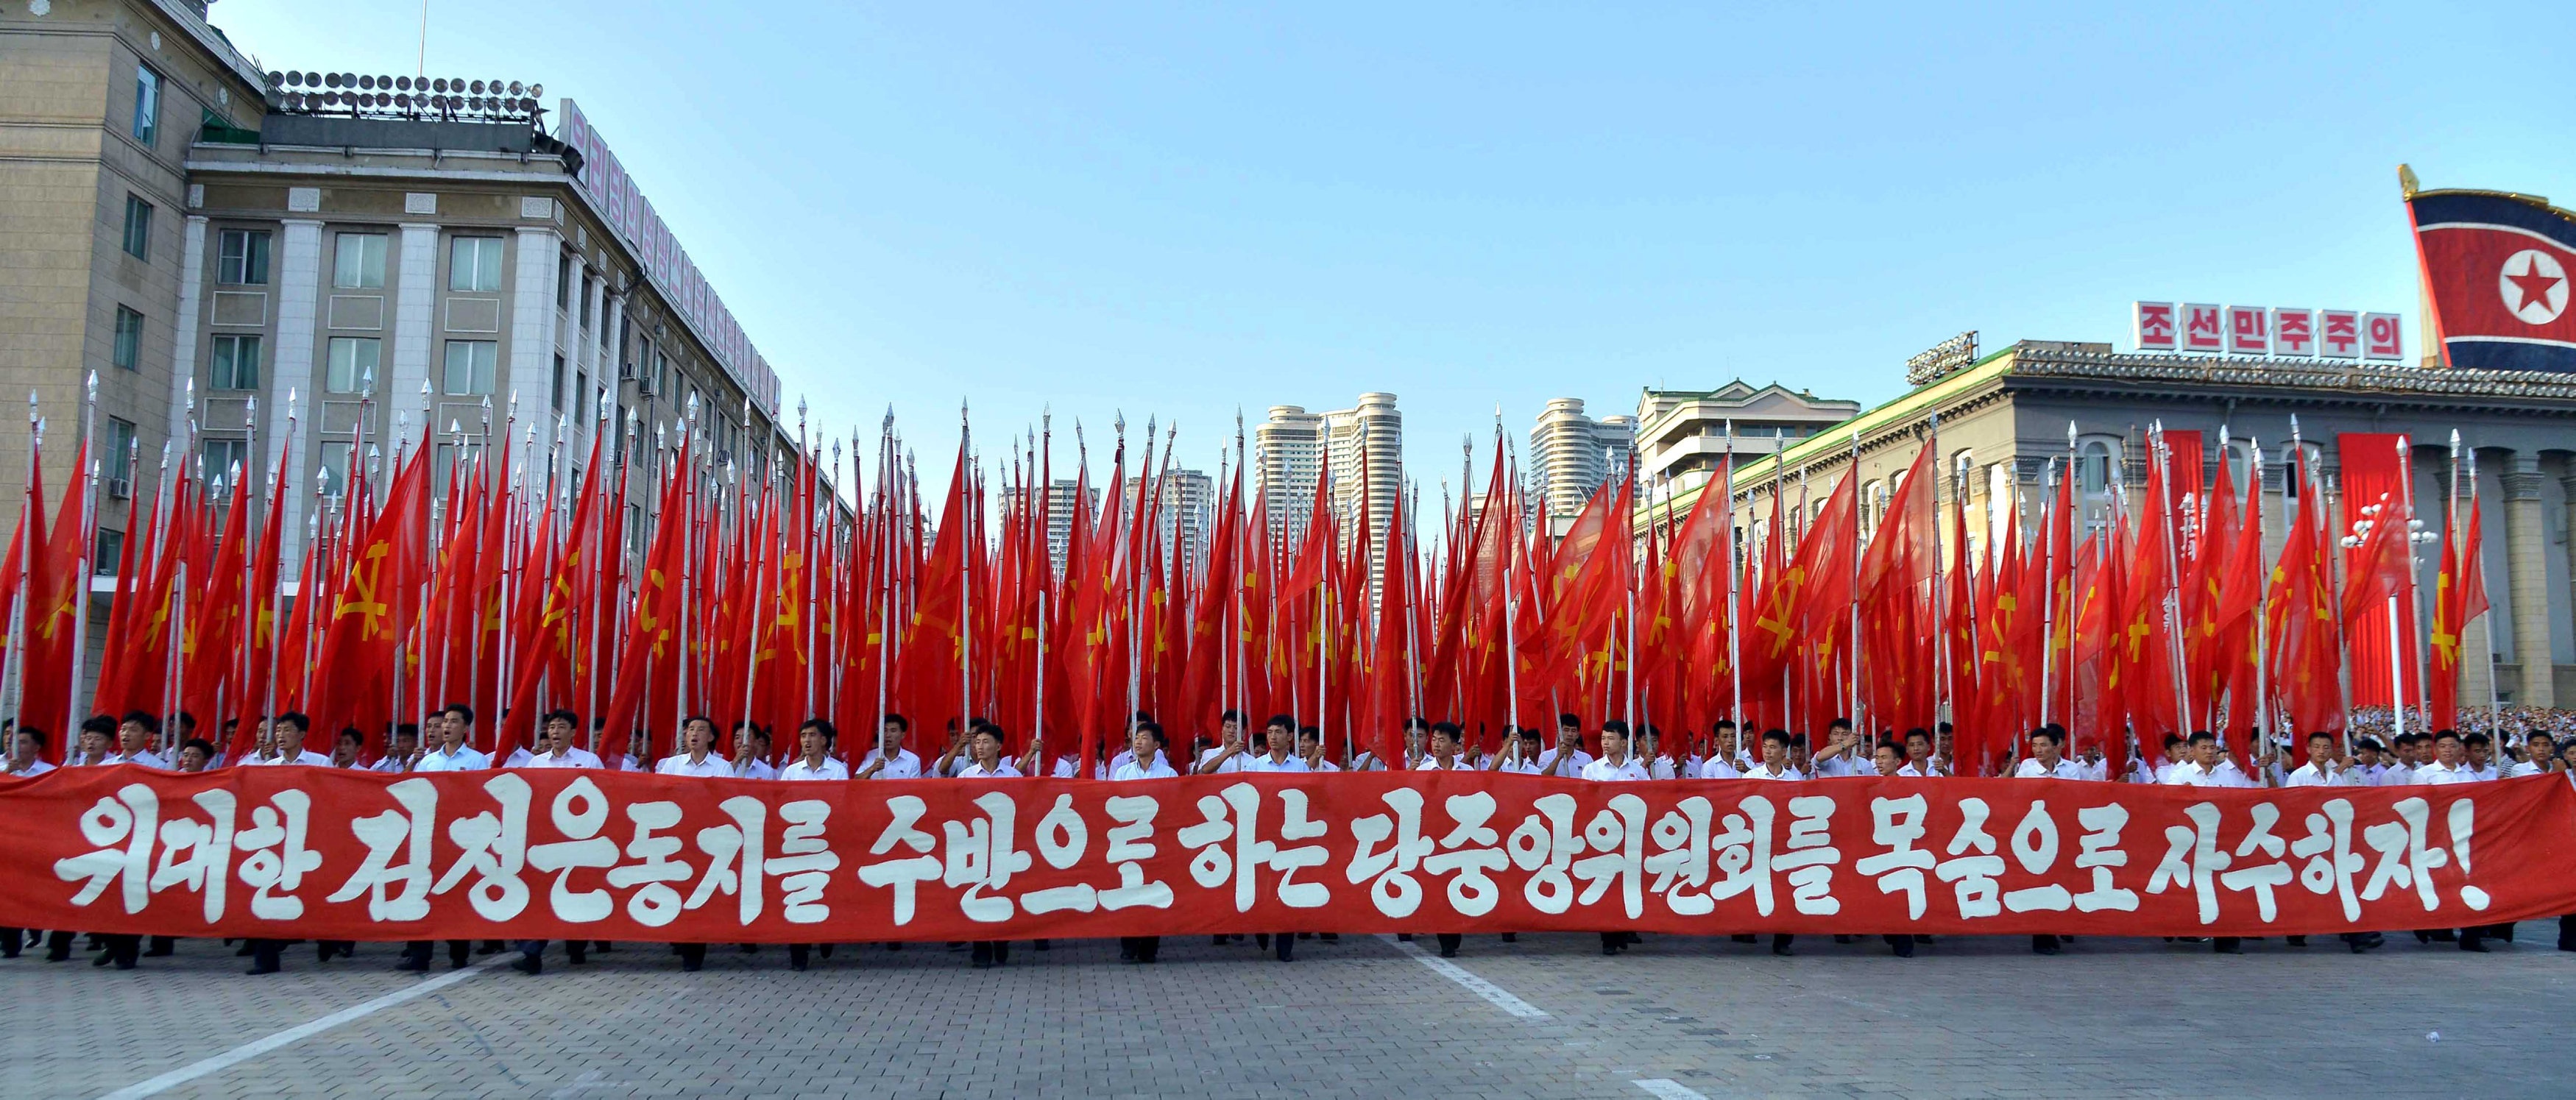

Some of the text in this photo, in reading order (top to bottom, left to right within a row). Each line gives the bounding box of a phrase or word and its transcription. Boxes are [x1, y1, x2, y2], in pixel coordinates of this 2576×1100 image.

[2142, 305, 2400, 355] 조선민주주의
[54, 773, 2491, 927] 위대한 김정은동지를 수반으로 하는 당중앙위원회를 목숨으로 사수하자!
